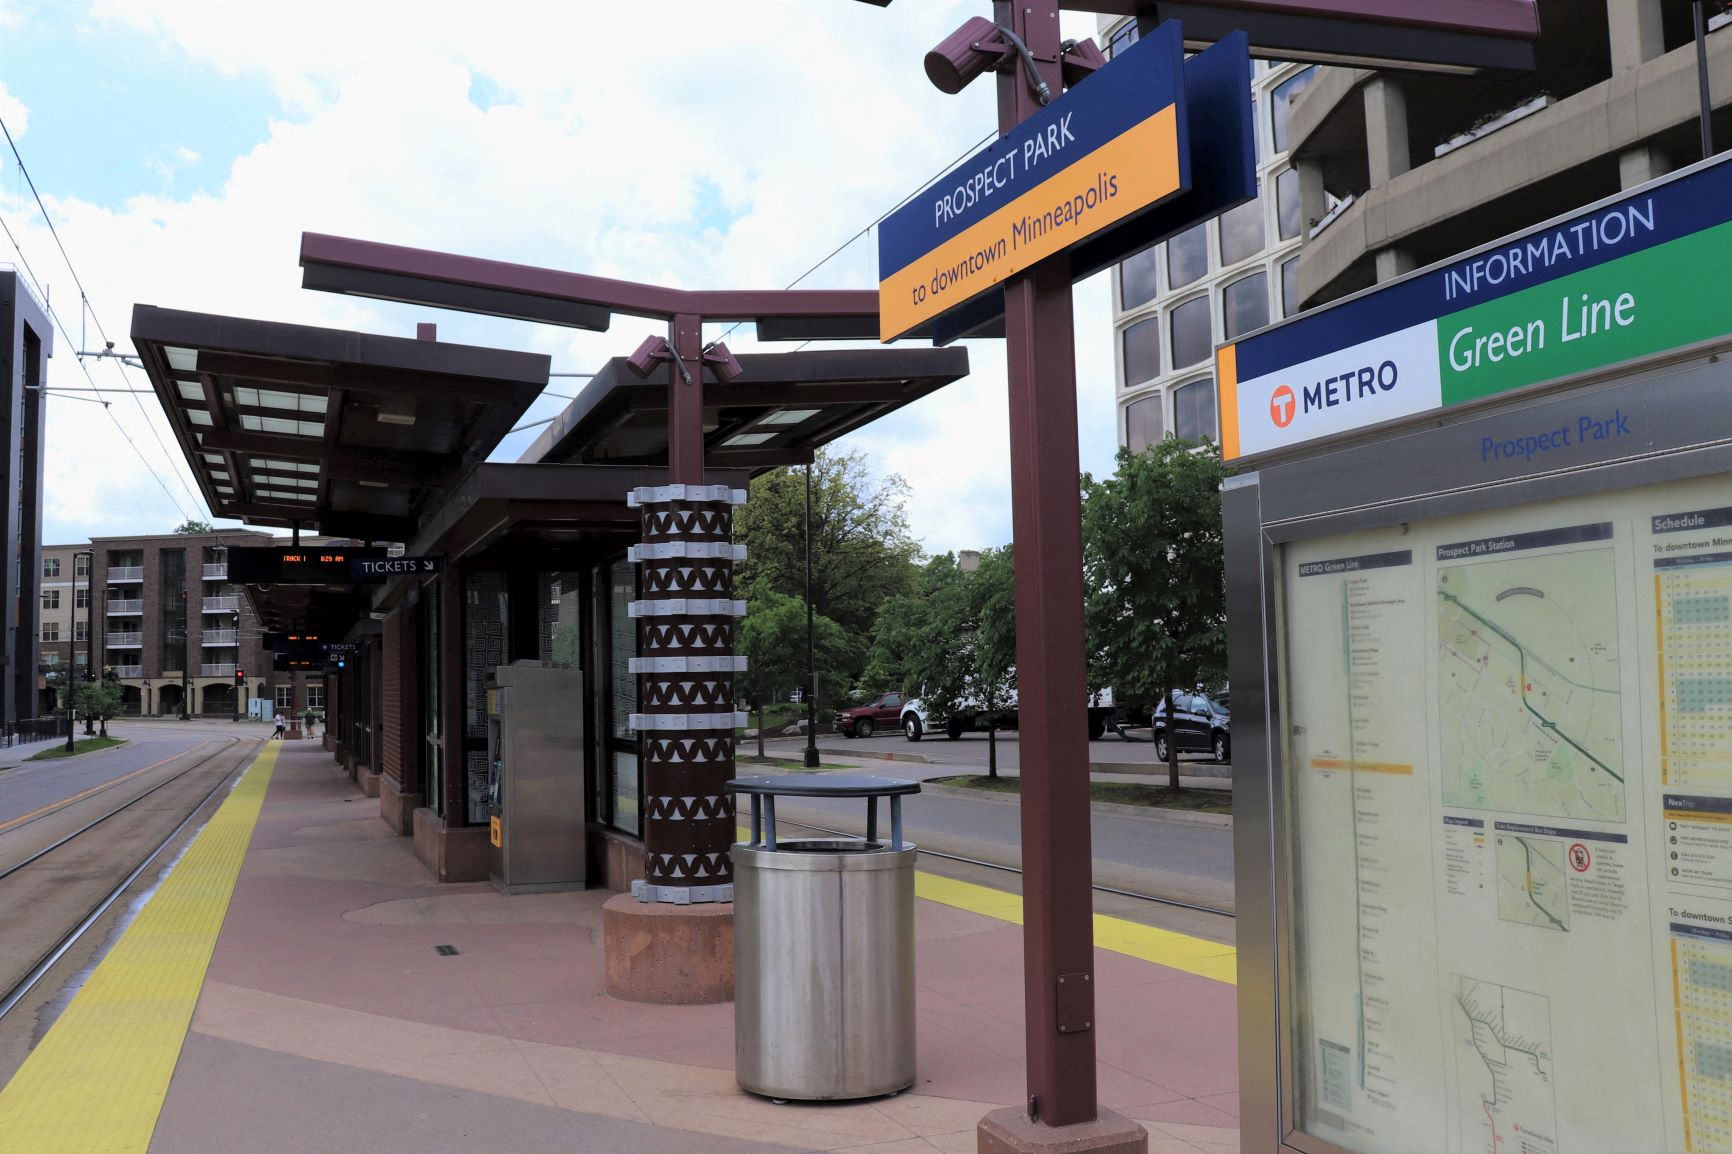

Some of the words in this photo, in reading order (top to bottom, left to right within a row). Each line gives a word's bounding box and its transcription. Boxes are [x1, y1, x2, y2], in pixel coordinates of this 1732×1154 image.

[935, 149, 1018, 228] PROSPECT
[1024, 112, 1076, 171] PARK
[912, 284, 926, 306] to
[930, 237, 1006, 296] downtown
[1012, 172, 1118, 251] Minneapolis
[1444, 198, 1656, 301] INFORMATION
[1448, 318, 1546, 372] Green
[1560, 292, 1636, 342] Line
[1302, 359, 1398, 414] METRO
[1481, 426, 1571, 462] Prospect
[1578, 409, 1630, 444] Park
[1654, 514, 1704, 530] Schedule
[1438, 546, 1469, 558] Prospect
[1470, 543, 1487, 553] Park
[1488, 539, 1515, 551] Station
[1653, 544, 1663, 552] To
[1666, 542, 1710, 552] downtown
[362, 560, 416, 573] TICKETS
[1300, 564, 1323, 575] METRO
[1324, 562, 1344, 572] Green
[1346, 560, 1359, 570] Line
[1668, 908, 1678, 917] To
[1681, 908, 1725, 924] downtown
